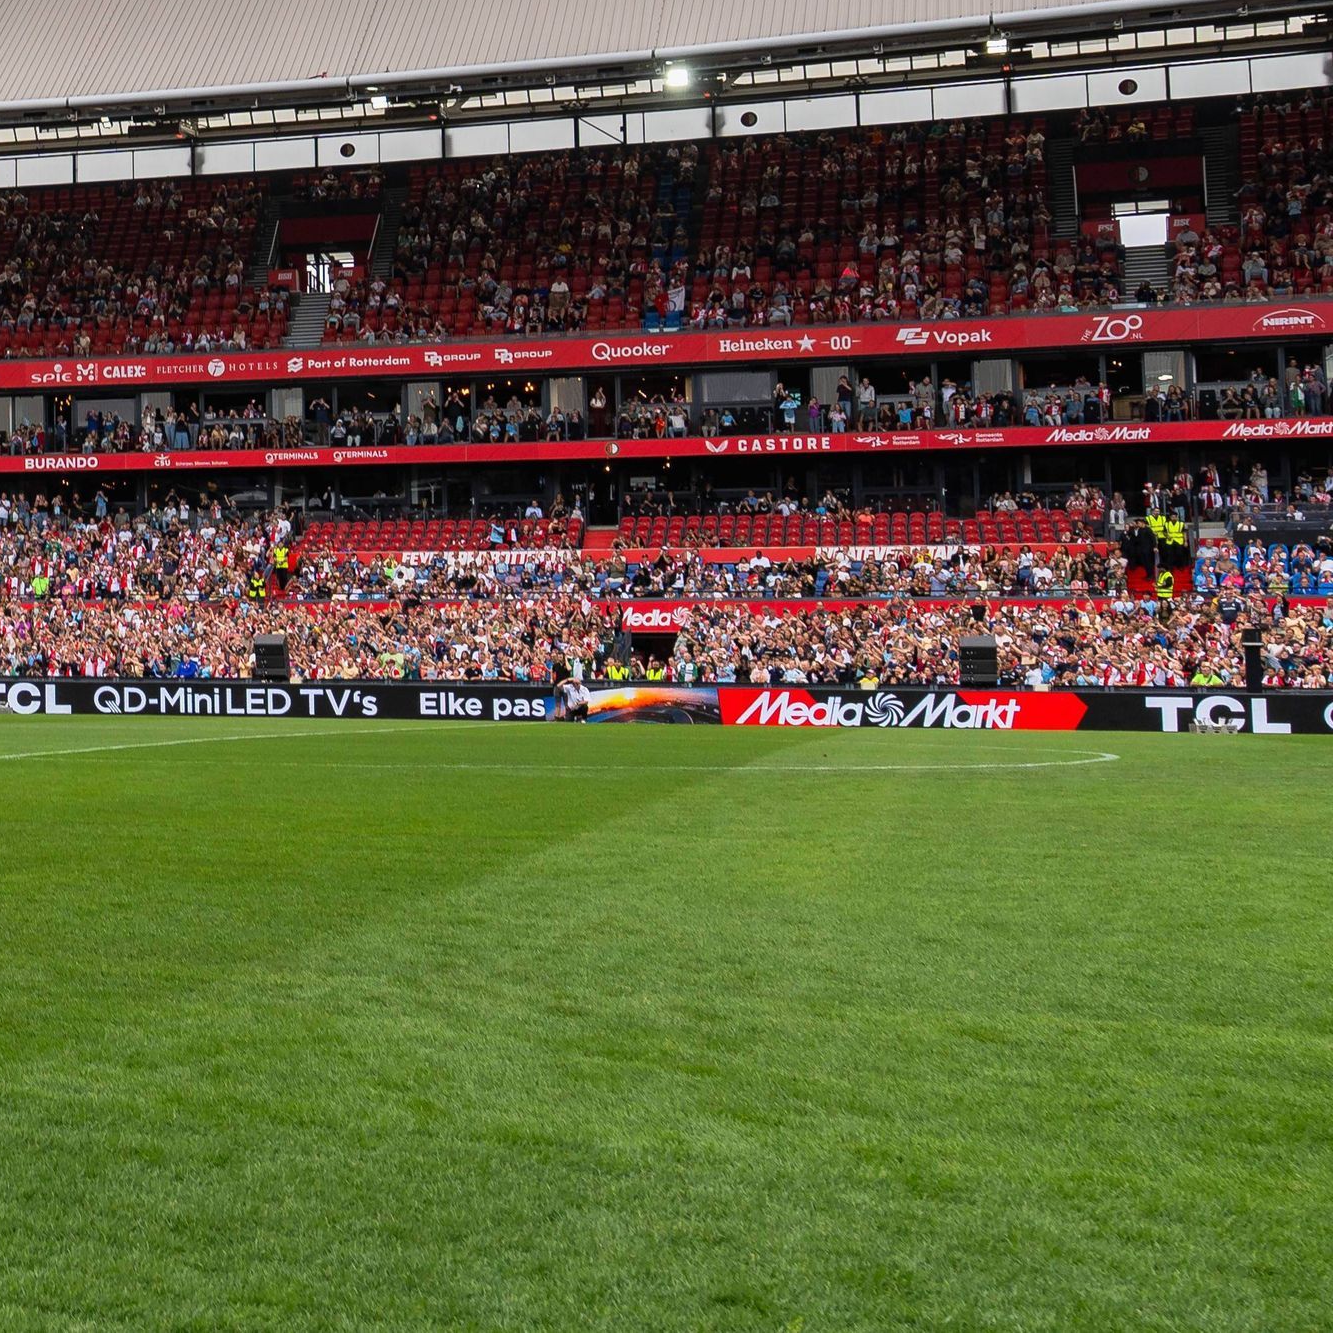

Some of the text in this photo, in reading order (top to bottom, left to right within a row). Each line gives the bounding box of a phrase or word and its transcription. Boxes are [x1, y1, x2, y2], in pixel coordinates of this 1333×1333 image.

[1263, 316, 1314, 326] NIRINT
[933, 329, 992, 346] Vopak
[1081, 328, 1093, 343] THE
[591, 342, 669, 361] Quooker
[719, 338, 793, 353] Heineken
[307, 355, 410, 369] Port of Rotterdam
[443, 353, 481, 362] GROUP
[514, 350, 553, 359] GROUP
[156, 361, 278, 374] FLETCHER HOTELS
[1046, 427, 1151, 442] Media Markt
[1222, 421, 1333, 437] Media Markt
[737, 437, 831, 452] CASTORE
[24, 457, 98, 470] BURANDO
[420, 692, 546, 721] Elke pas
[735, 691, 1020, 729] Media Markt
[1145, 695, 1291, 734] TCL
